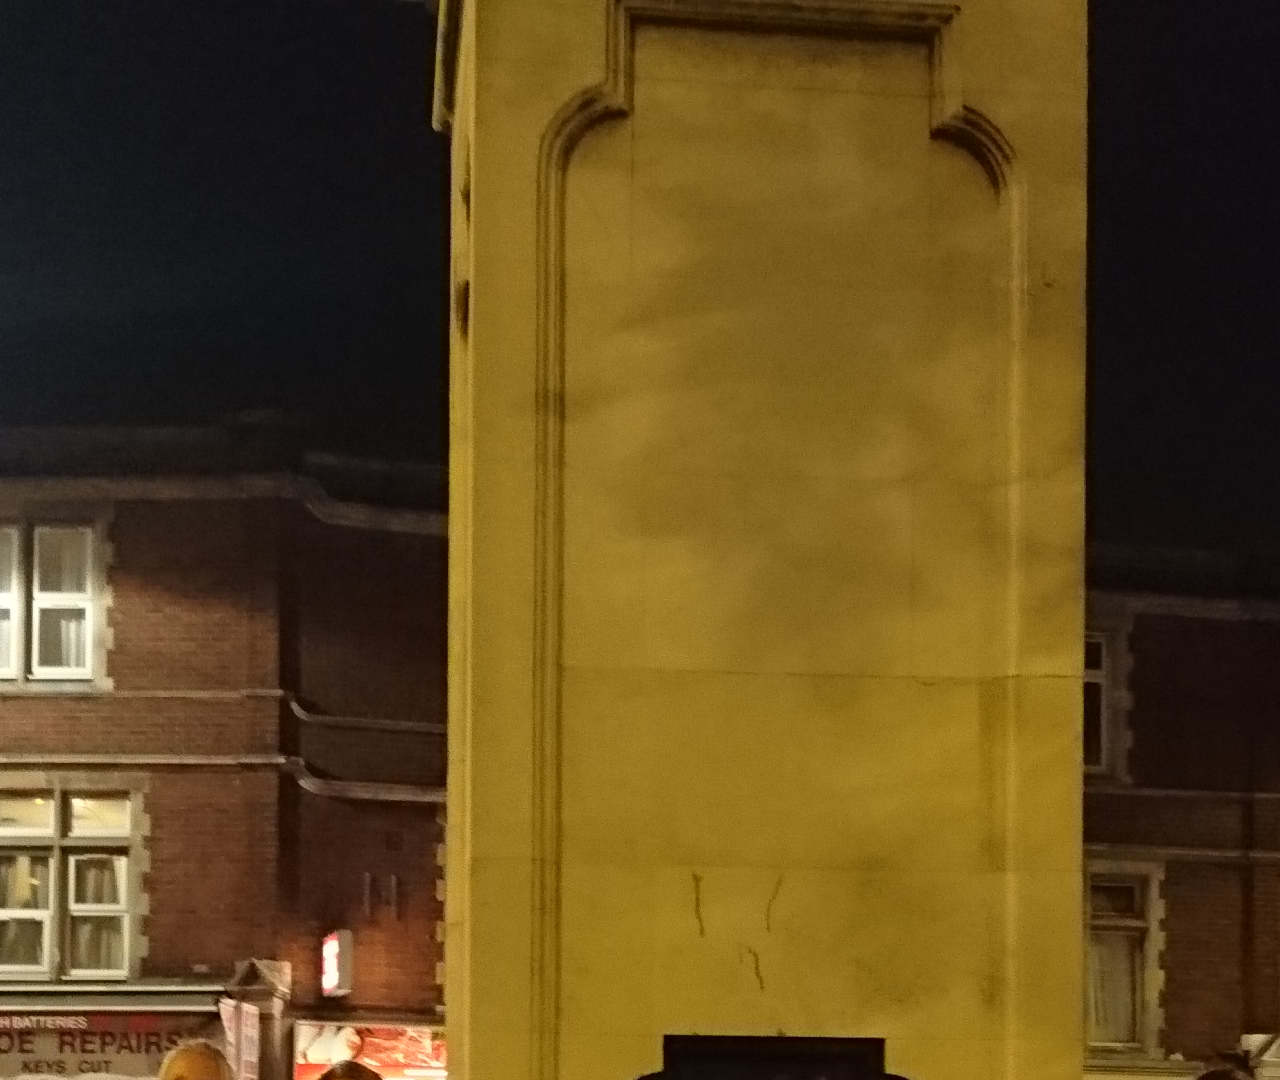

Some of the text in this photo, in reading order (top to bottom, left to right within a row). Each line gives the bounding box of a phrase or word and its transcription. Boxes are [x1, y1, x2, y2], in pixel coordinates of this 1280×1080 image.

[11, 1016, 88, 1029] BATTERIES
[58, 1032, 181, 1054] REPAIRS
[20, 1060, 112, 1073] KEYS CUT
